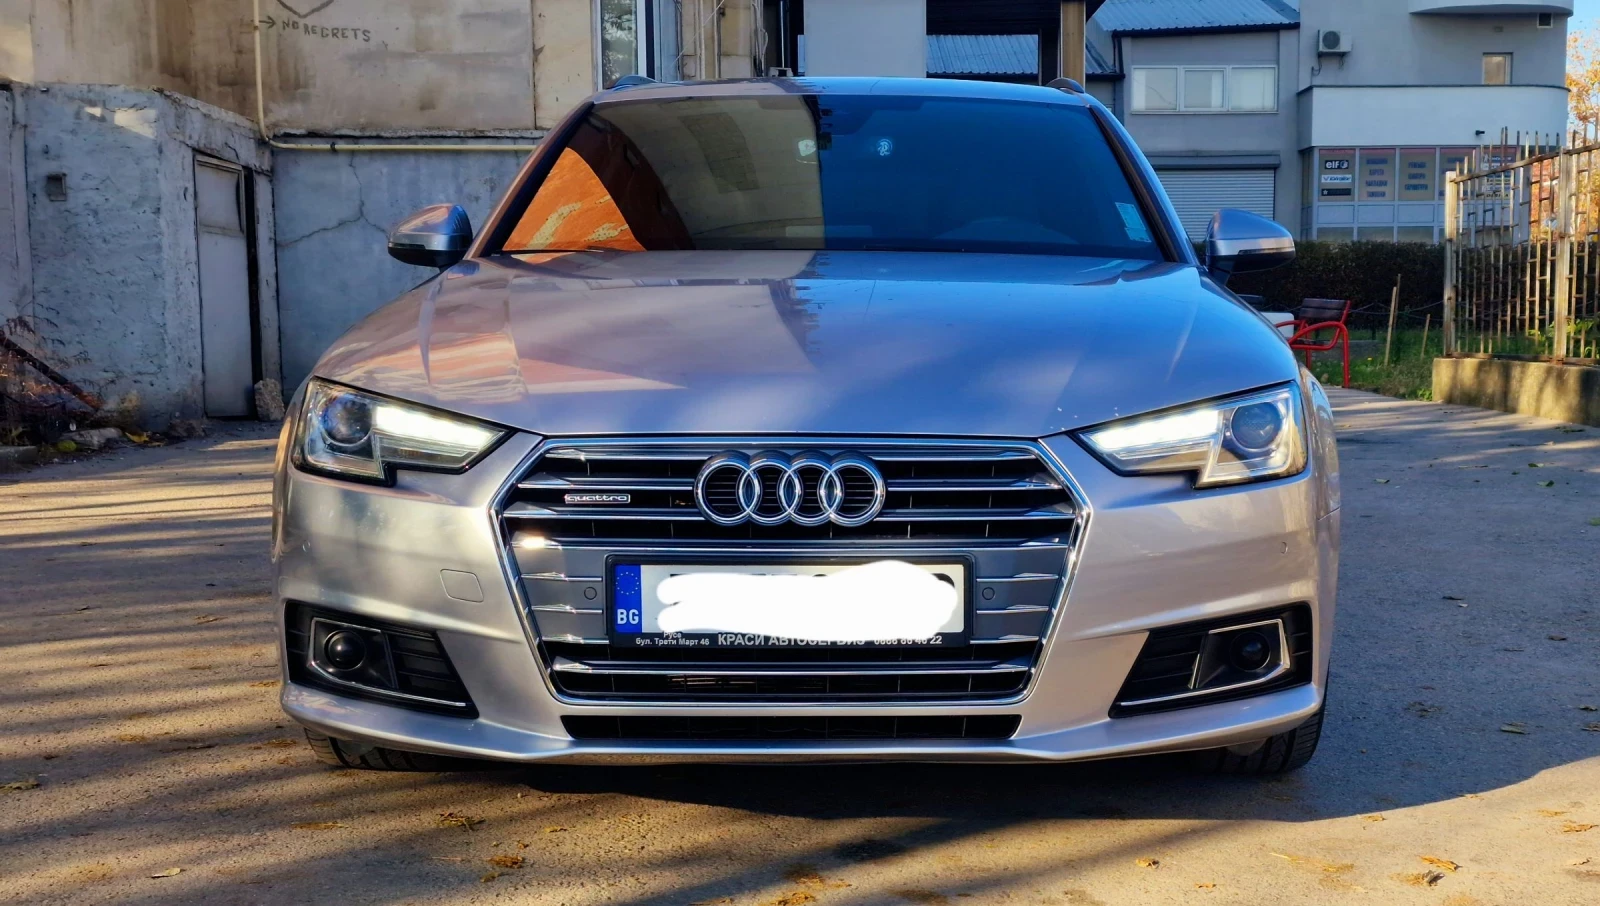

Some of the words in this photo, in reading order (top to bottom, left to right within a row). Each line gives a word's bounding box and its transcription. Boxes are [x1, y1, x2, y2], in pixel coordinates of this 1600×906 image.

[282, 19, 299, 30] NO
[303, 23, 371, 42] REGRETS
[1325, 161, 1339, 169] elf
[567, 494, 627, 502] quattro
[617, 608, 639, 625] BG
[678, 638, 699, 646] Март
[700, 638, 710, 646] 46
[717, 633, 765, 646] КРАСИ
